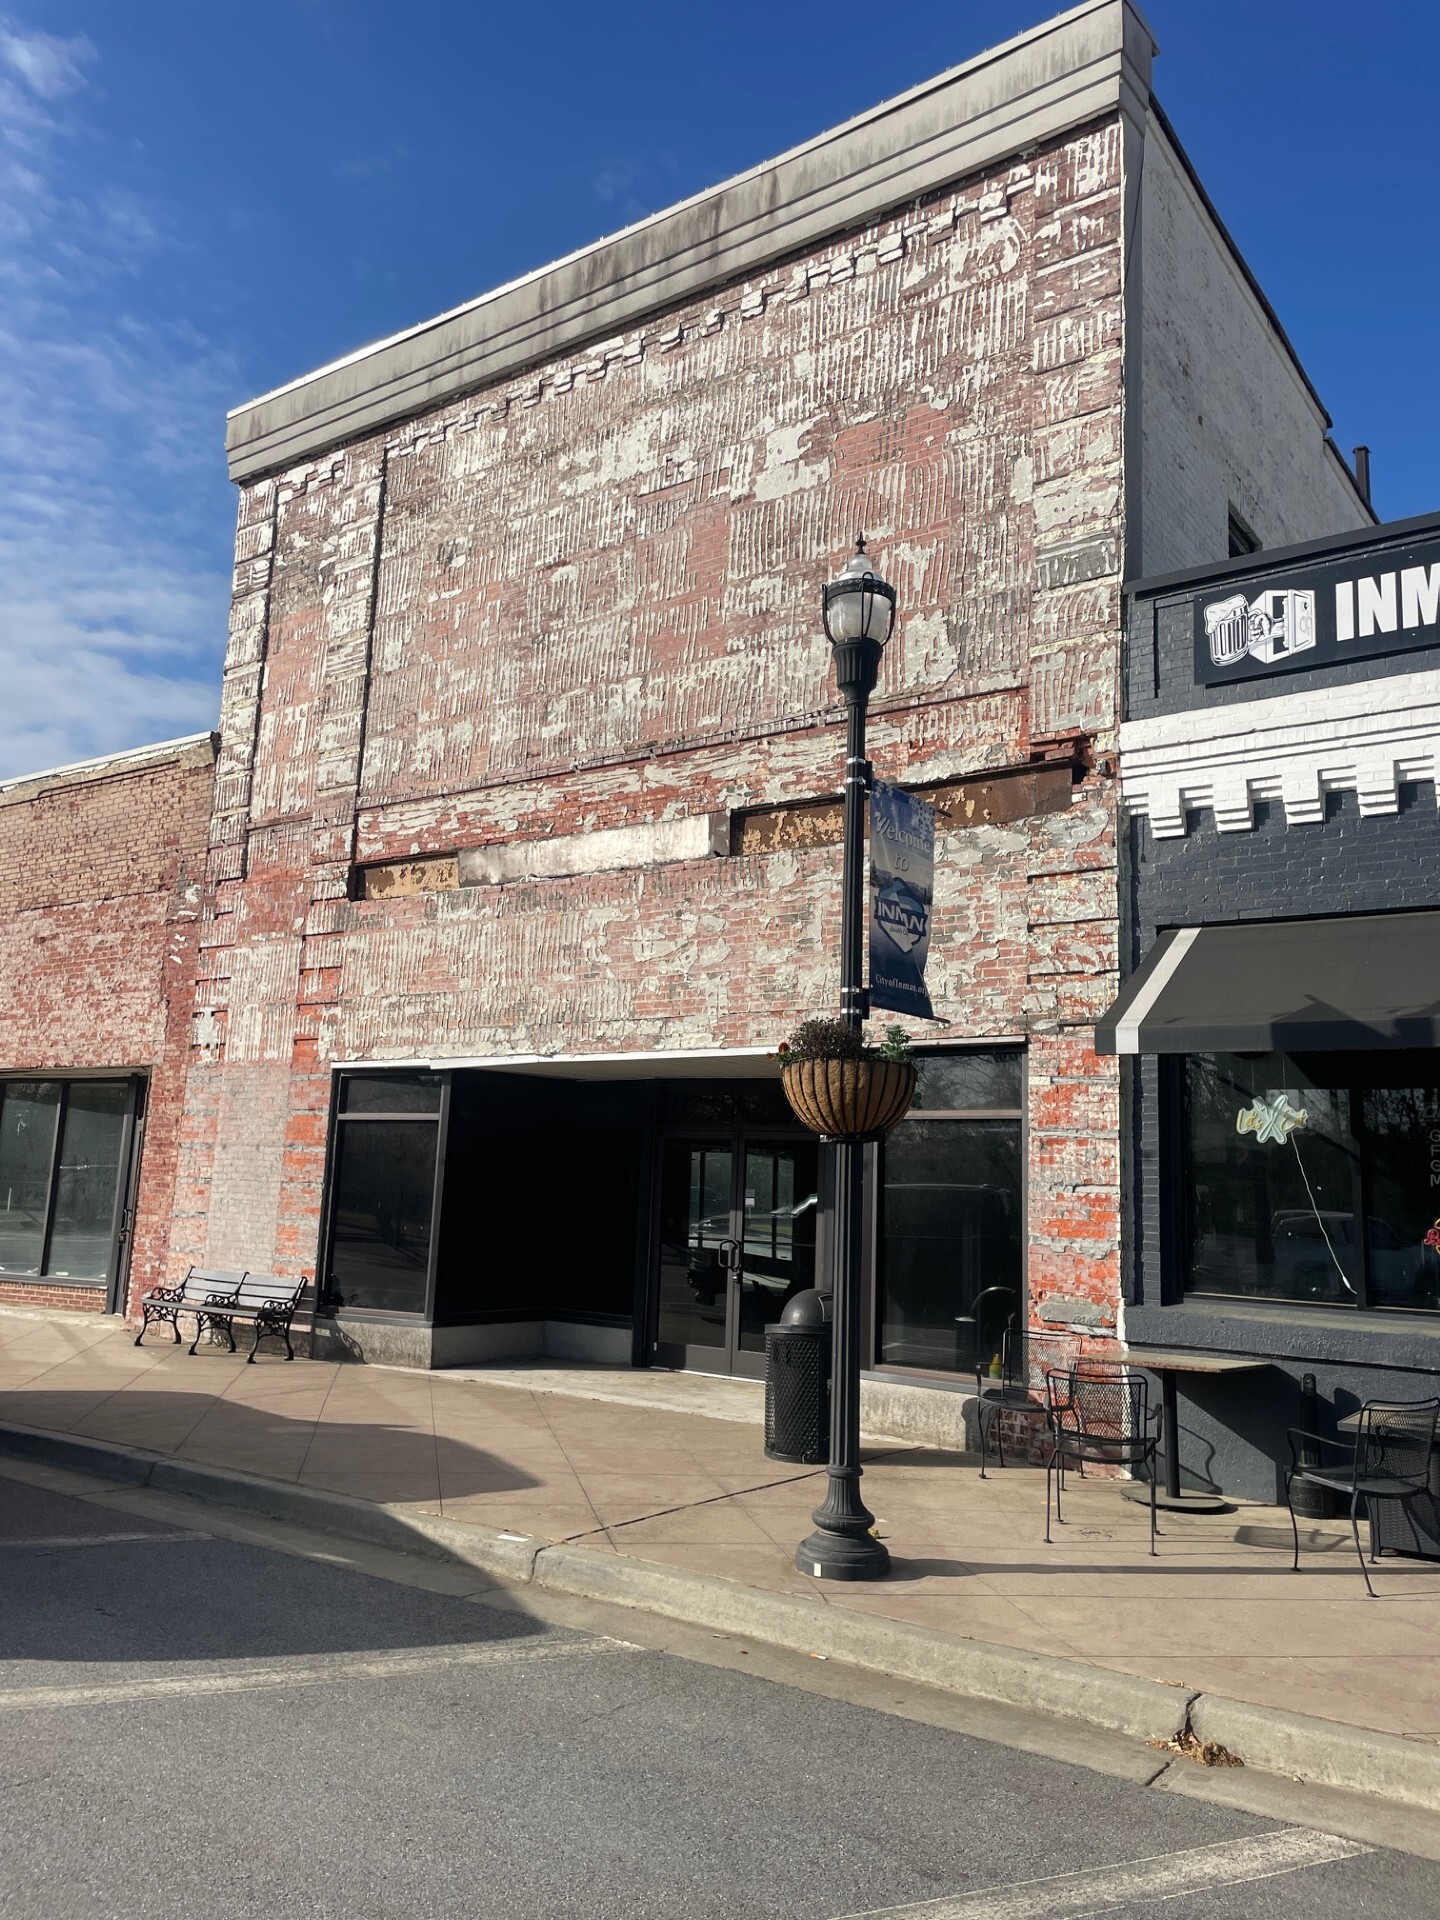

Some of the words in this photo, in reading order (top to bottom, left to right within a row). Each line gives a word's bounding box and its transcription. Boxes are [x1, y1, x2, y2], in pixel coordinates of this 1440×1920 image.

[1335, 562, 1440, 641] INM
[874, 811, 931, 854] Welcome
[895, 852, 910, 872] to
[1237, 1108, 1263, 1133] Let's
[1281, 1109, 1307, 1132] Eat
